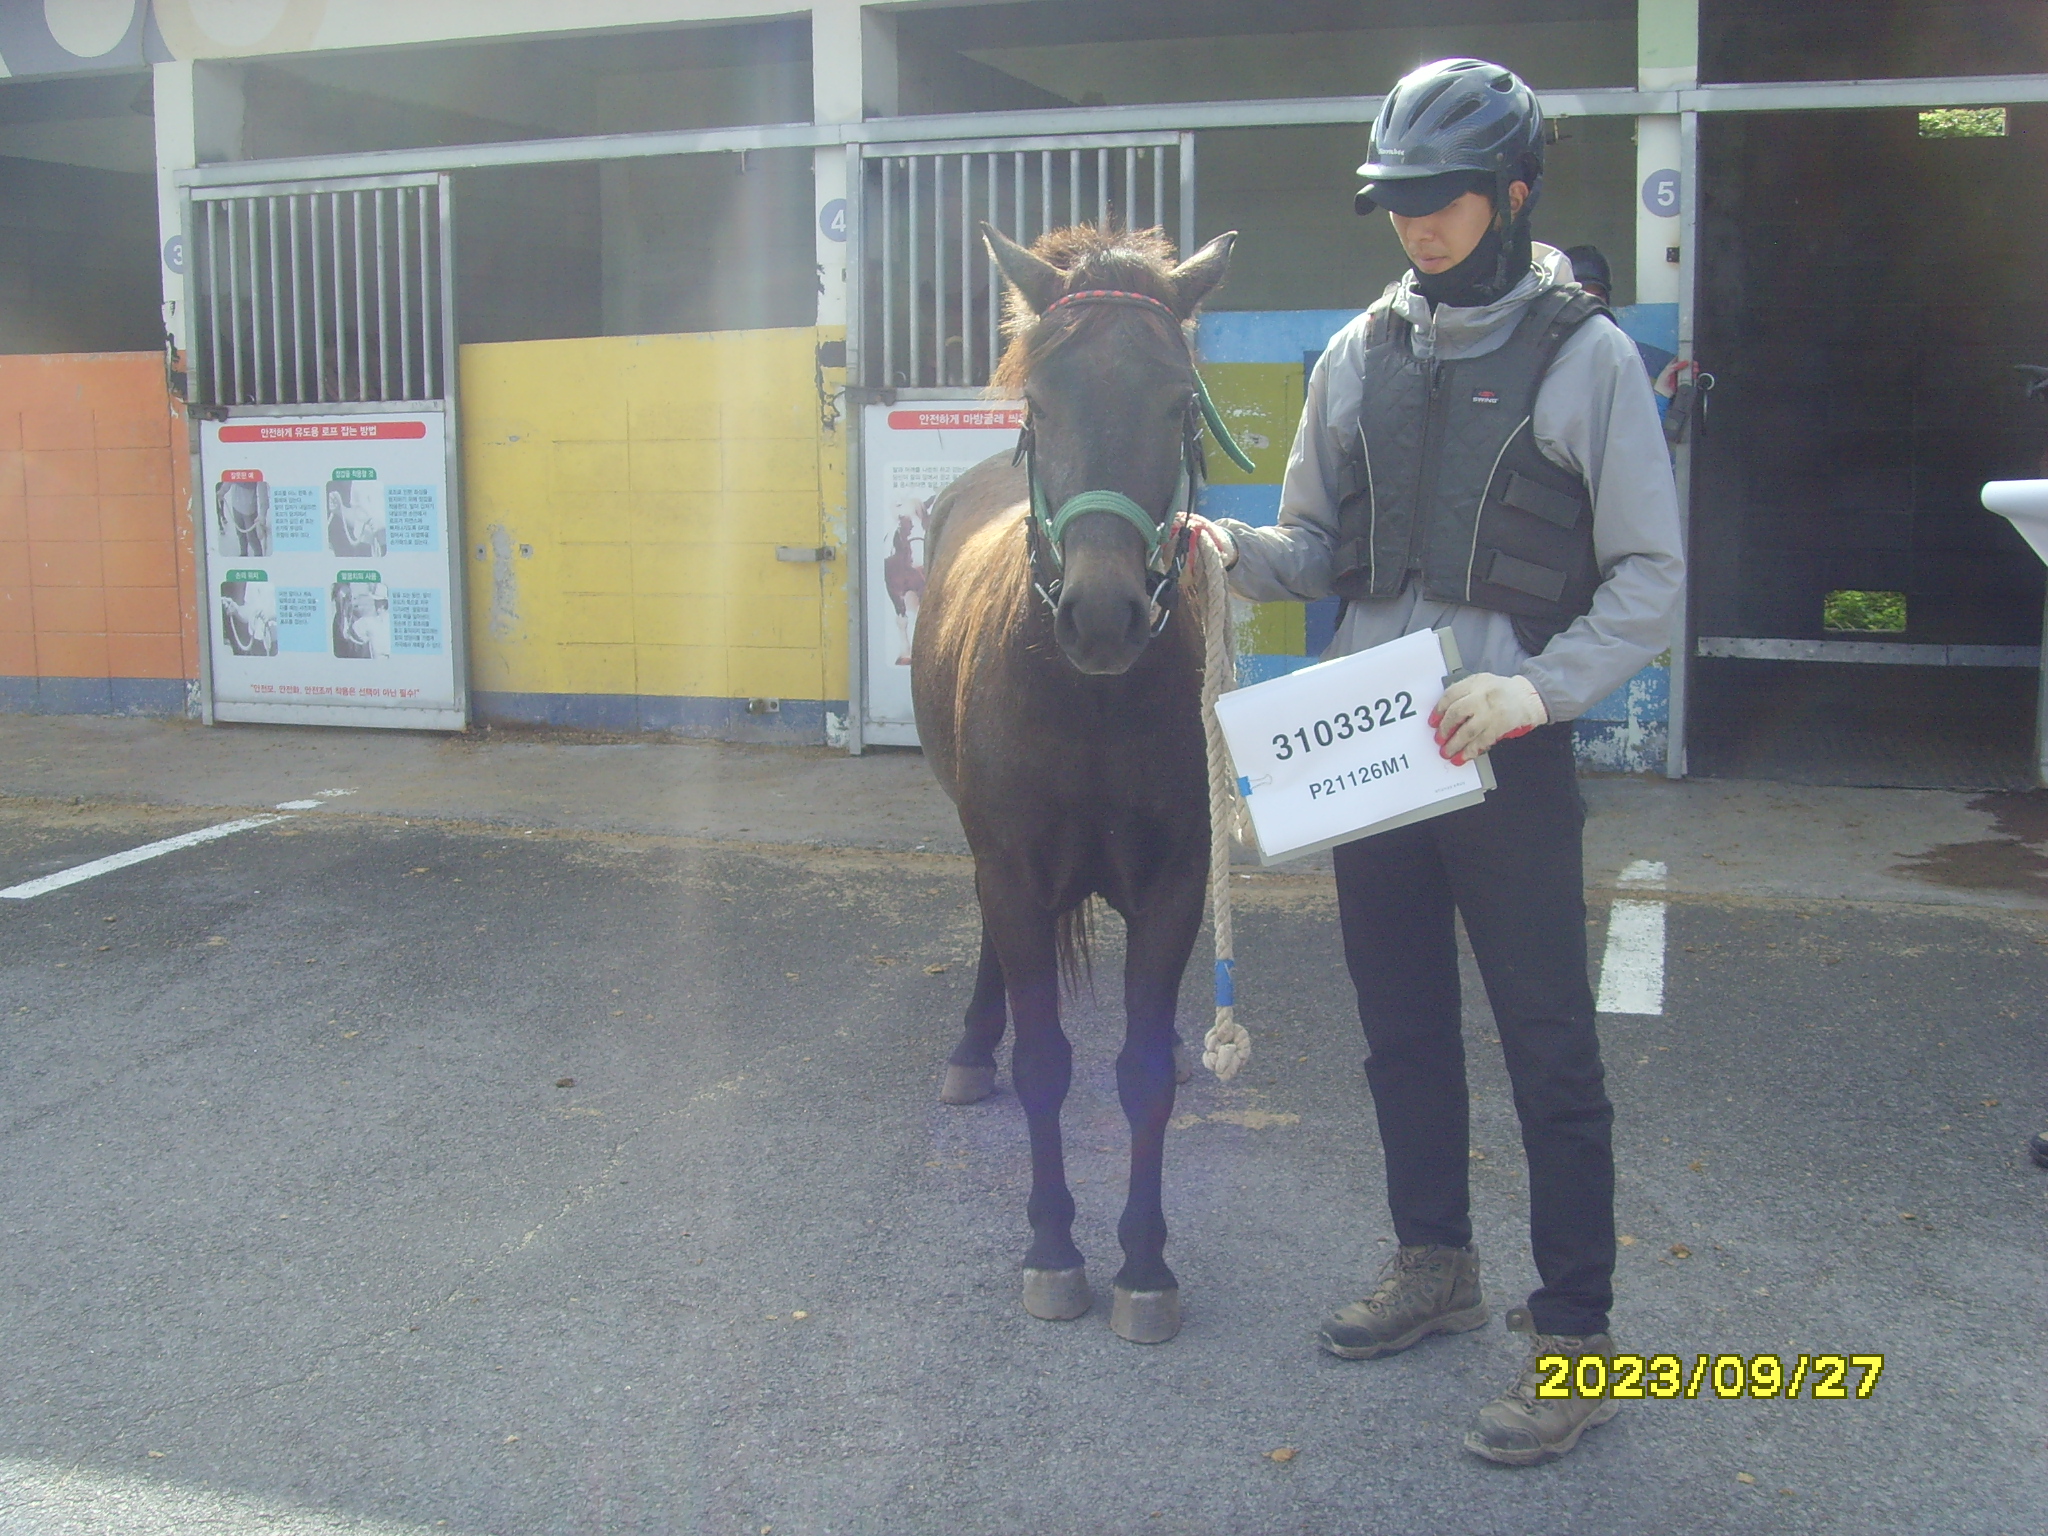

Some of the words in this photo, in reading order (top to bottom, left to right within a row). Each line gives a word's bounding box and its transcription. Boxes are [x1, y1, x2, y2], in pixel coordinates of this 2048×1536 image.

[1657, 181, 1675, 206] 5
[831, 209, 846, 232] 4
[173, 244, 183, 266] 3
[919, 414, 959, 425] 안전하게
[963, 413, 1004, 425] 마방굴레
[261, 427, 292, 438] 안전하게
[295, 427, 319, 438] 유도용
[322, 427, 338, 437] 로프
[341, 426, 357, 437] 잡는
[360, 426, 377, 436] 방법
[304, 686, 333, 696] 안전조끼
[335, 687, 356, 697] 착용은
[359, 687, 380, 697] 선택이
[383, 688, 397, 698] 아닌
[1272, 691, 1417, 760] 3103322
[1309, 754, 1411, 799] P21126M1
